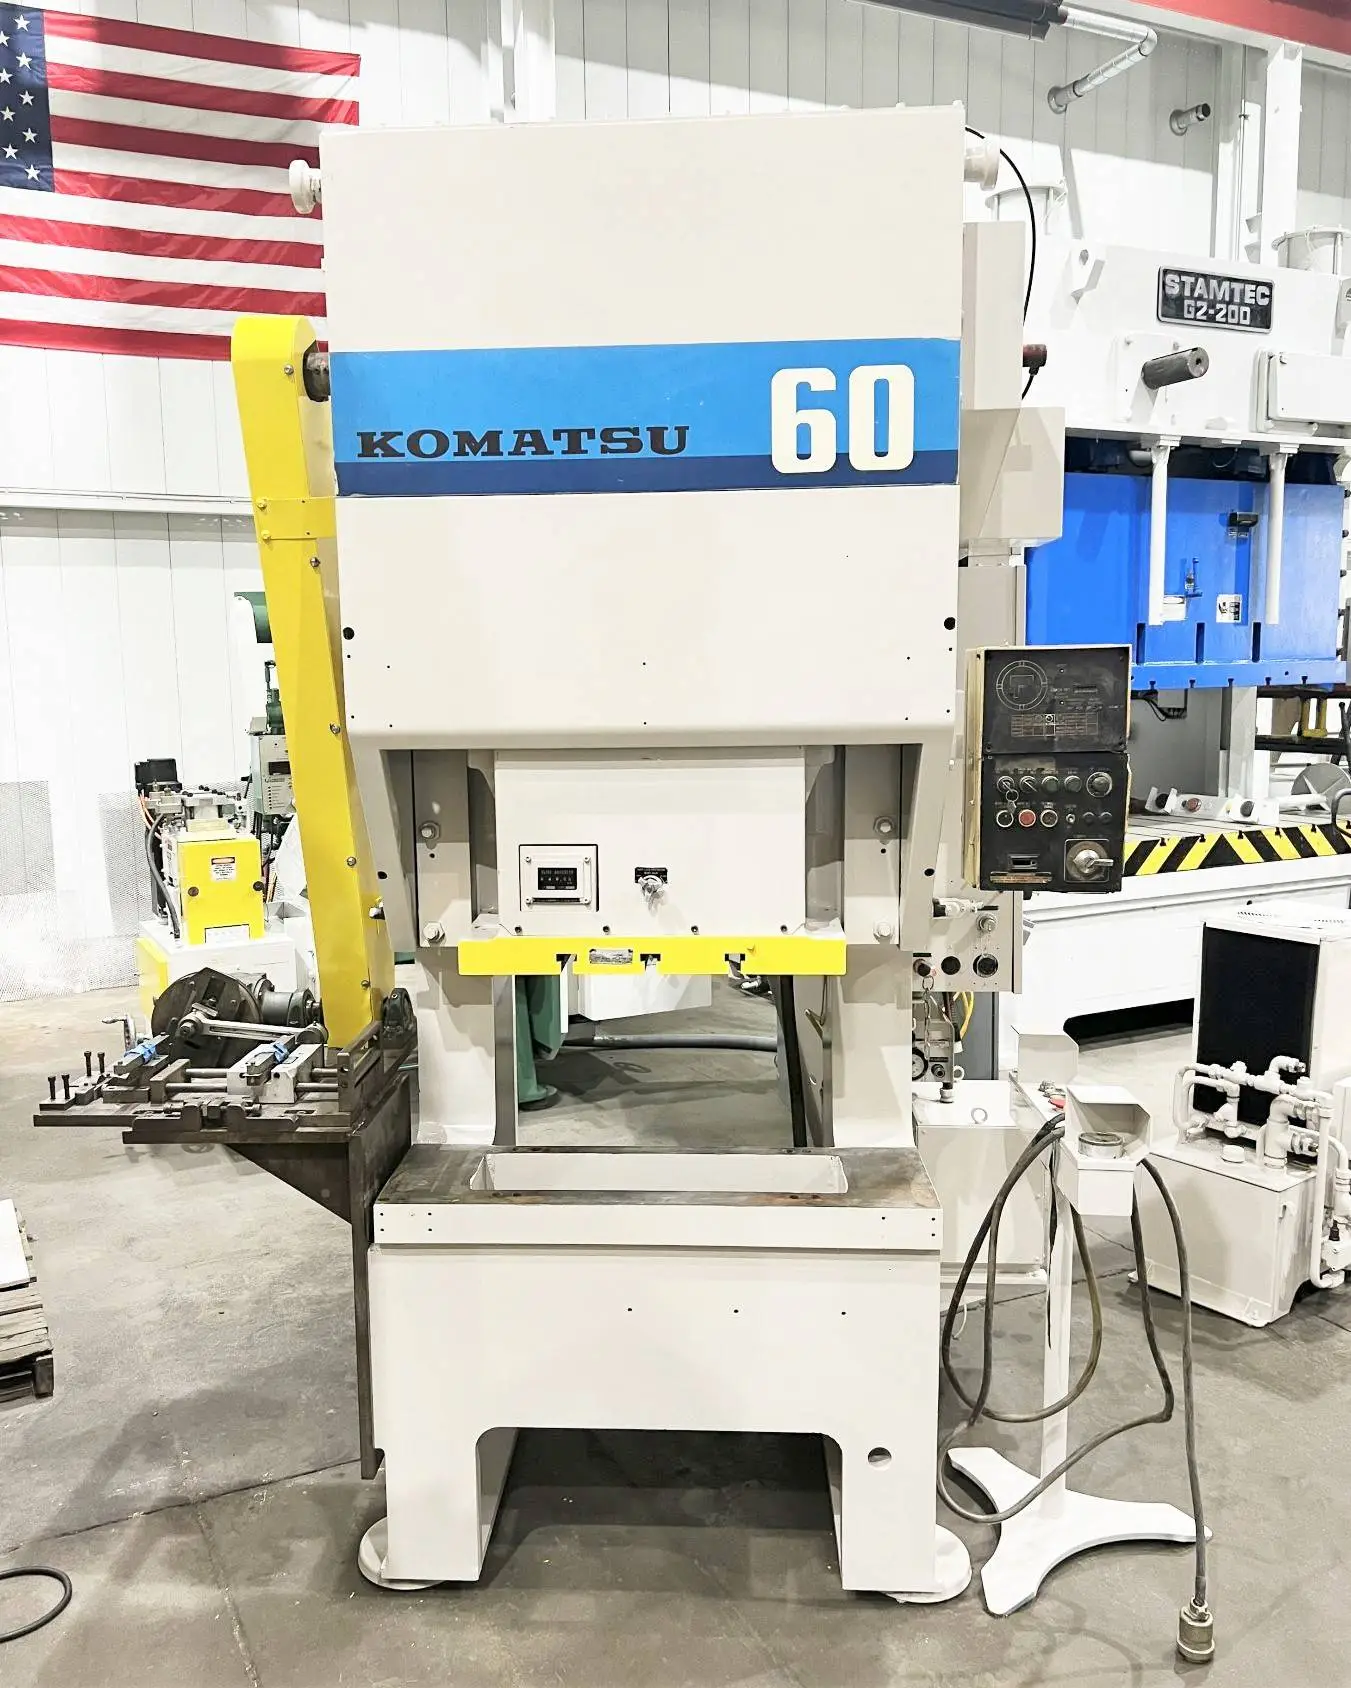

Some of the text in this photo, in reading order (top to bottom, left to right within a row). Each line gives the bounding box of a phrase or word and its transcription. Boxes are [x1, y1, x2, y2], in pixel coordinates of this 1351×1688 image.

[1165, 274, 1270, 305] STAMTEC
[1183, 299, 1251, 325] G2-200
[771, 364, 915, 474] 60
[357, 425, 690, 459] KOMATSU
